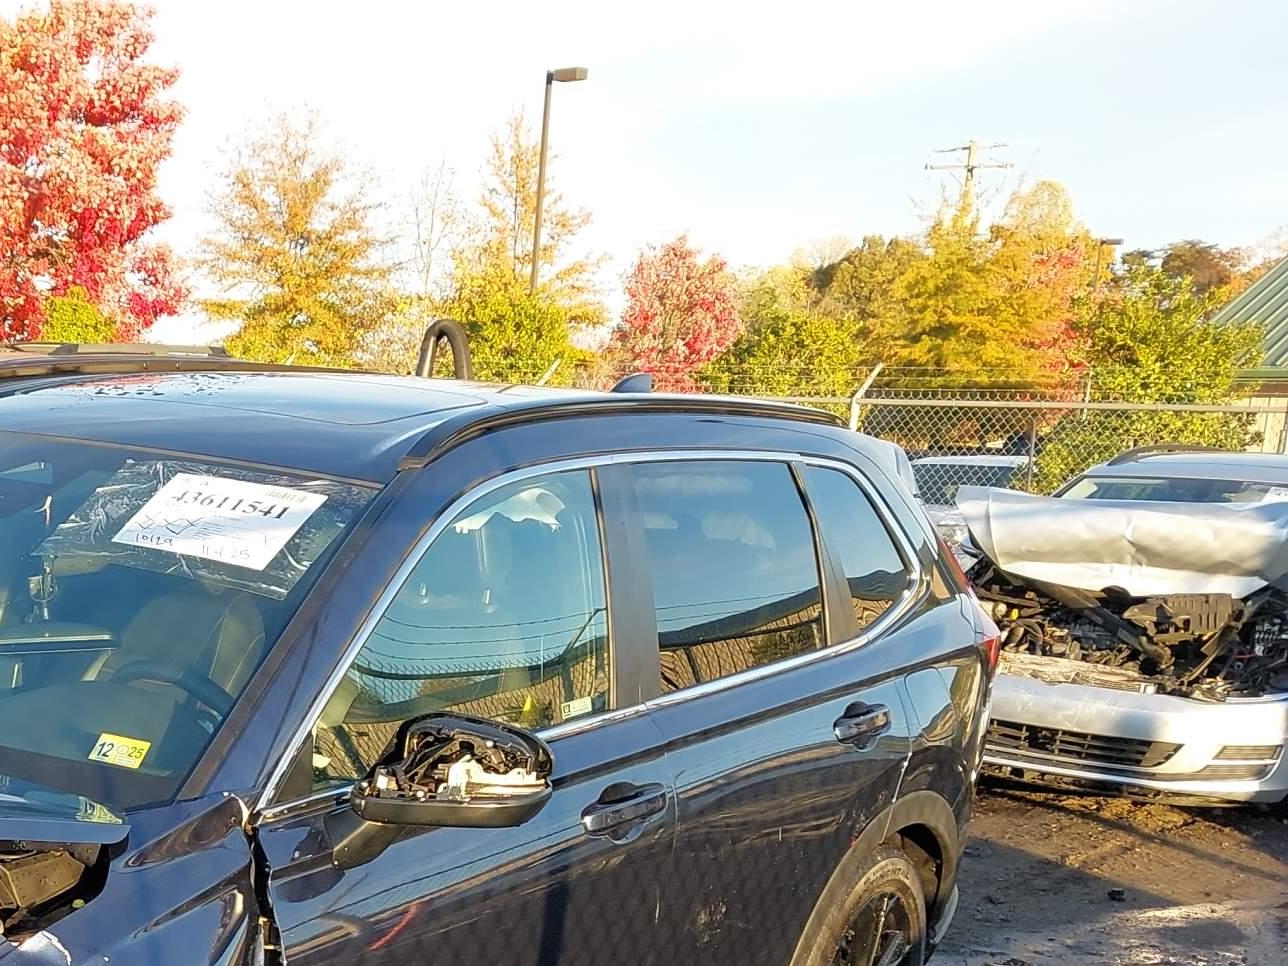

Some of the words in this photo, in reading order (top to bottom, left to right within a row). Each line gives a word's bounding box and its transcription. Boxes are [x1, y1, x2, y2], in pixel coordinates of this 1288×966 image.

[172, 490, 290, 519] 43611541
[97, 742, 114, 757] 12
[128, 747, 144, 759] 25
